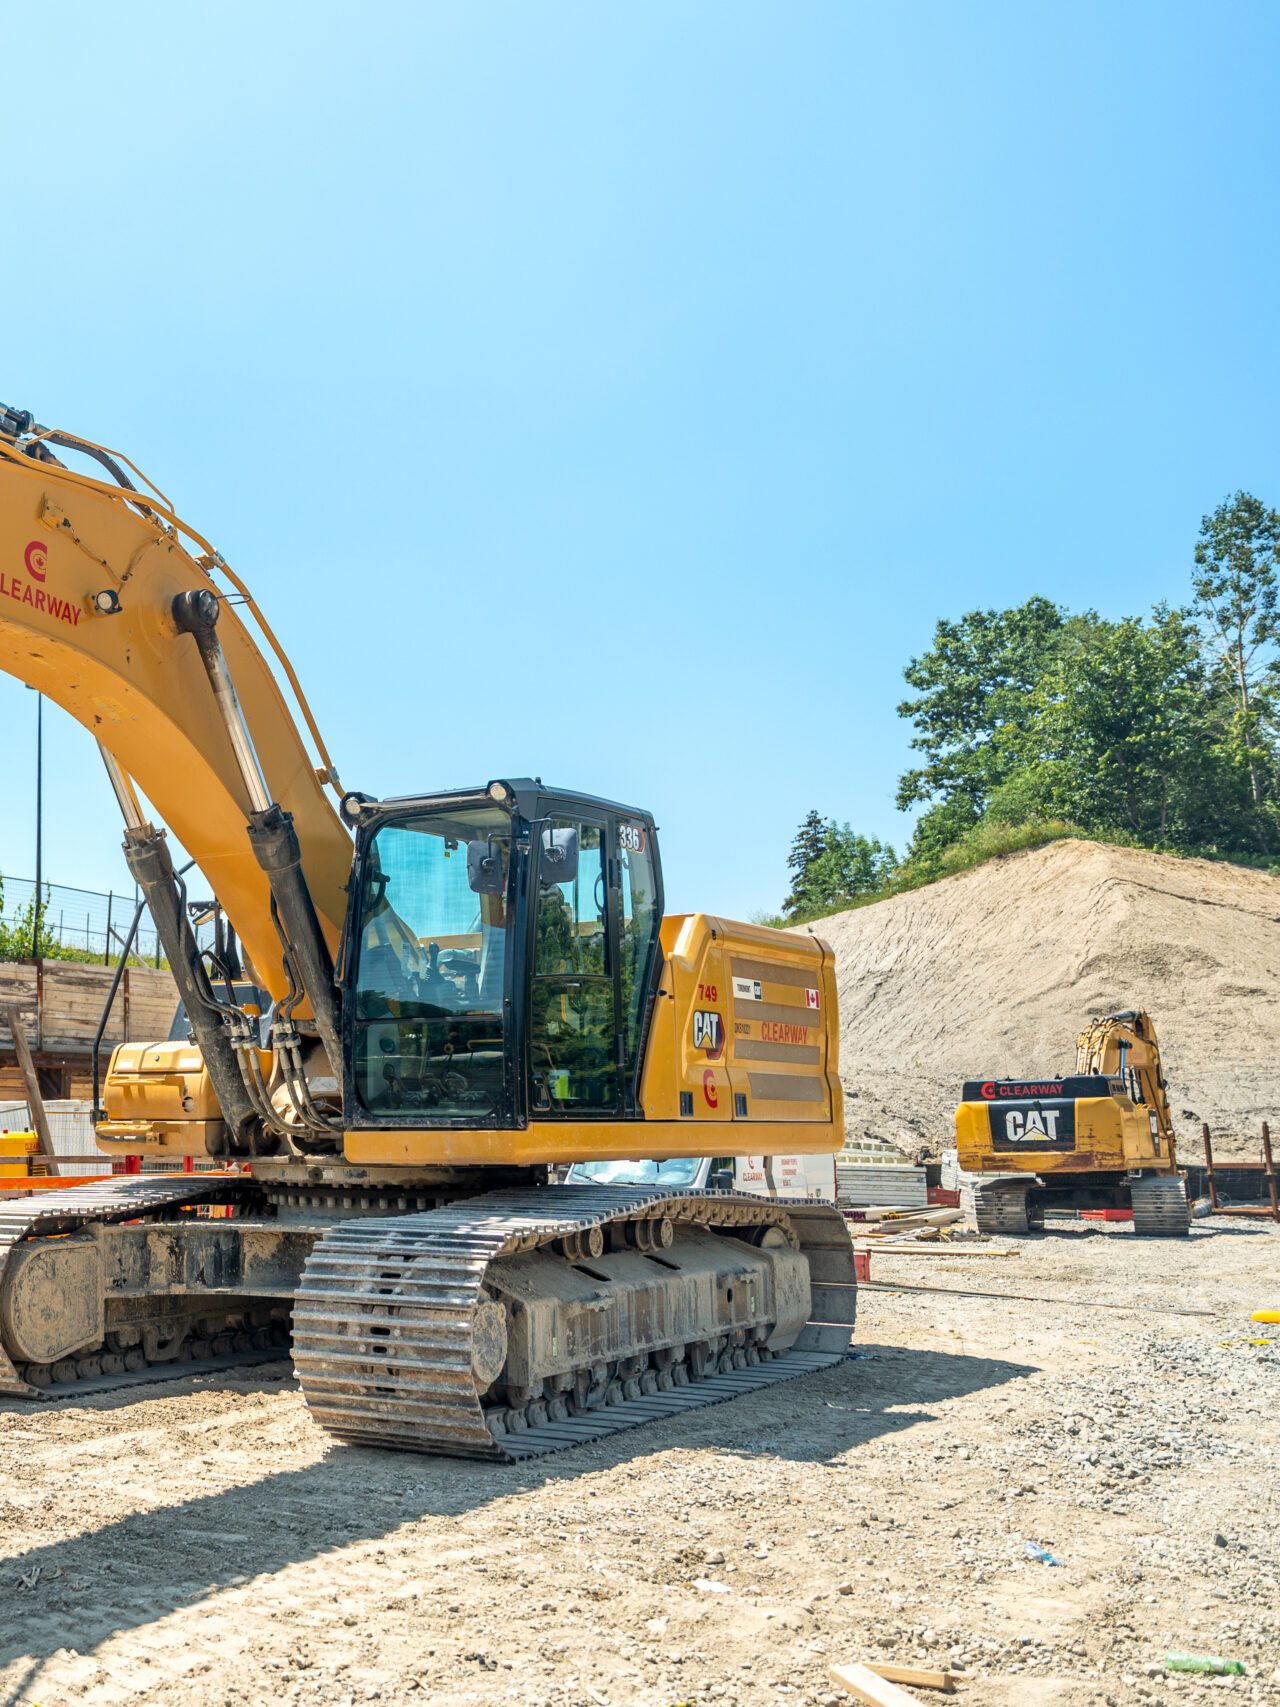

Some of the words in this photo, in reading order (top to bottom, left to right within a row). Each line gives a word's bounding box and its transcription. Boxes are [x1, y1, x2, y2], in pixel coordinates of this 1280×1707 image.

[620, 825, 639, 850] 336
[698, 984, 718, 1002] 749
[693, 1011, 719, 1049] CAT
[761, 1022, 808, 1044] CLEARWAY
[1000, 1084, 1063, 1096] CLEARWAY
[1006, 1110, 1059, 1141] CAT
